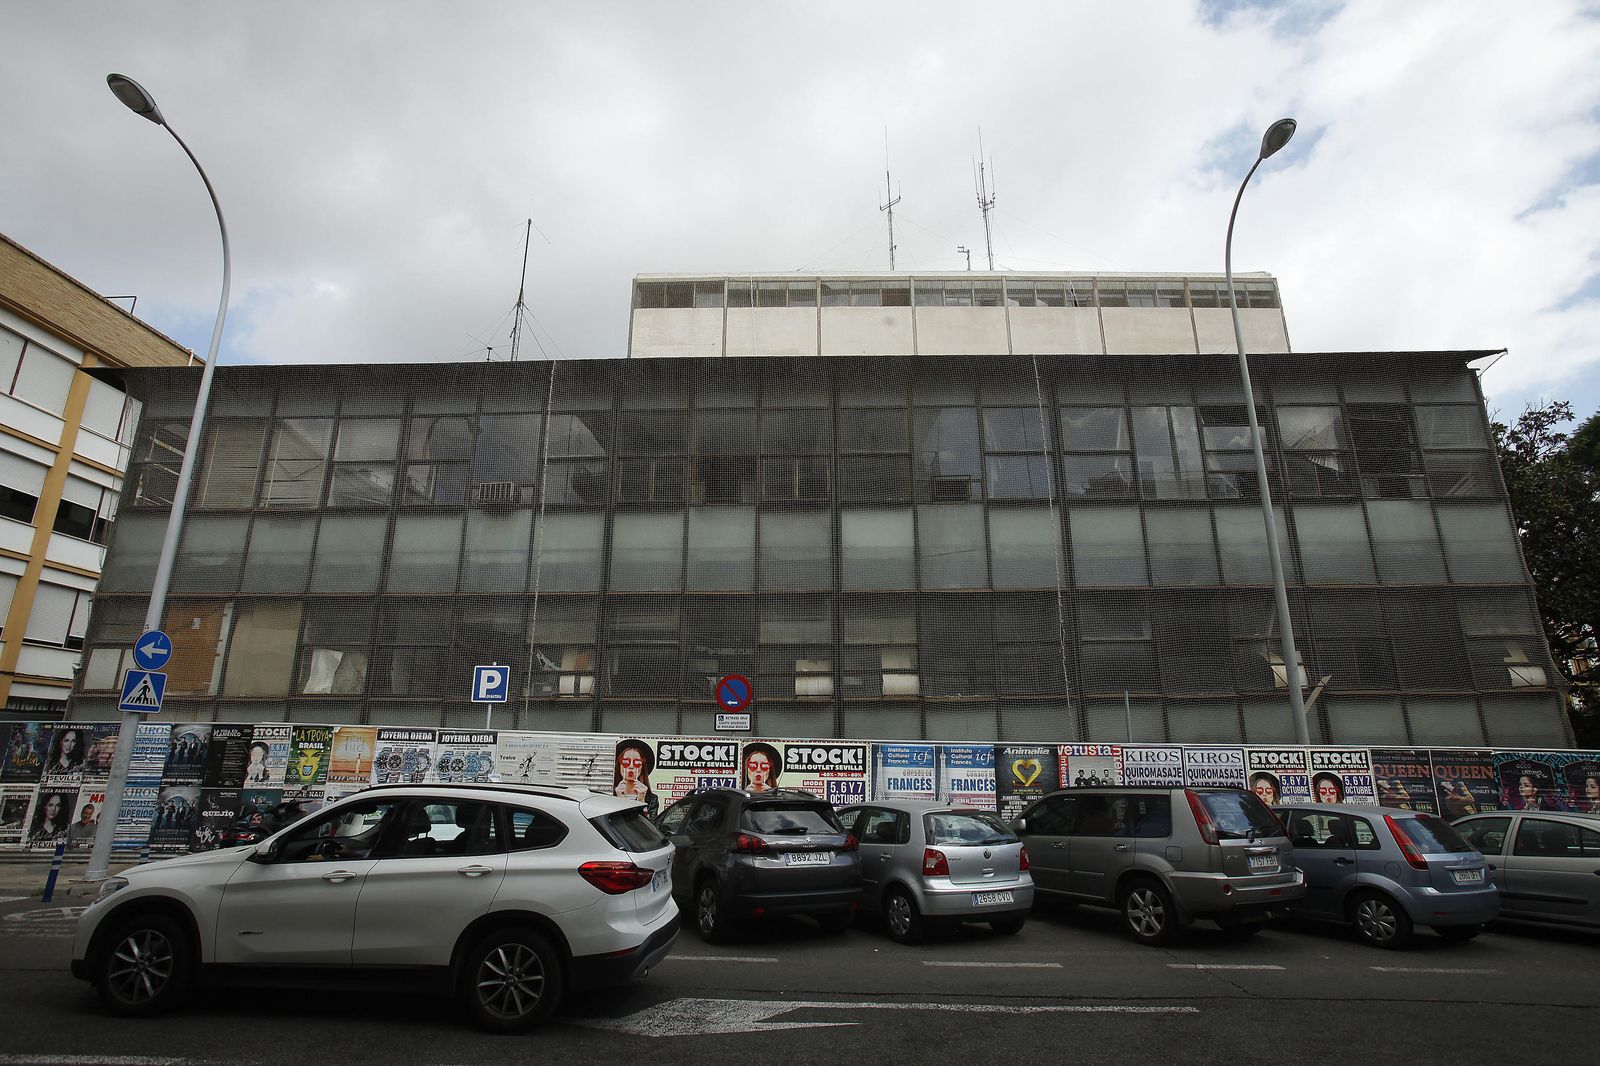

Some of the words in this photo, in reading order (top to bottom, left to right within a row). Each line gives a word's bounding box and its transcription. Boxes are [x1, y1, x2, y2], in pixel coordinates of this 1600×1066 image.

[478, 670, 502, 698] P
[137, 726, 171, 734] KIROS
[253, 728, 290, 736] STOCK!
[296, 729, 306, 741] LA
[306, 730, 330, 742] TROYA
[380, 731, 409, 740] JOYERIA
[410, 732, 433, 741] OJEDA
[441, 734, 470, 743] JOYERIA
[470, 735, 494, 743] OJEDA
[660, 745, 735, 761] STOCK!
[787, 748, 863, 764] STOCK!
[1058, 745, 1112, 756] Vetusta
[1125, 750, 1180, 762] KIROS
[1187, 752, 1240, 763] KIROS
[1251, 752, 1304, 764] STOCK!
[1314, 752, 1366, 764] STOCK!
[1126, 766, 1182, 779] QUIROMASAJE
[1188, 768, 1244, 781] QUIROMASAJE
[1373, 764, 1430, 778] QUEEN
[1435, 765, 1494, 780] QUEEN
[728, 779, 733, 788] 7
[888, 776, 932, 790] FRANCÉS
[951, 778, 996, 791] FRANCÉS
[1290, 776, 1295, 785] 6
[1296, 776, 1301, 785] Y
[1302, 776, 1307, 785] 7
[1353, 776, 1358, 785] 6
[1359, 776, 1364, 785] Y
[1365, 776, 1370, 785] 7
[124, 788, 159, 796] KIROS
[831, 782, 838, 794] 5,
[841, 782, 846, 793] 6
[849, 782, 855, 793] Y
[857, 782, 862, 793] 7
[1282, 786, 1308, 794] OCTUBRE
[1346, 786, 1372, 794] OCTUBRE
[89, 794, 105, 803] MA
[831, 794, 863, 804] OCTUBRE
[202, 810, 234, 818] QUEJÍO
[792, 853, 811, 862] 8892
[814, 852, 828, 861] JZL
[979, 894, 996, 903] 2658
[998, 892, 1011, 901] CVD
